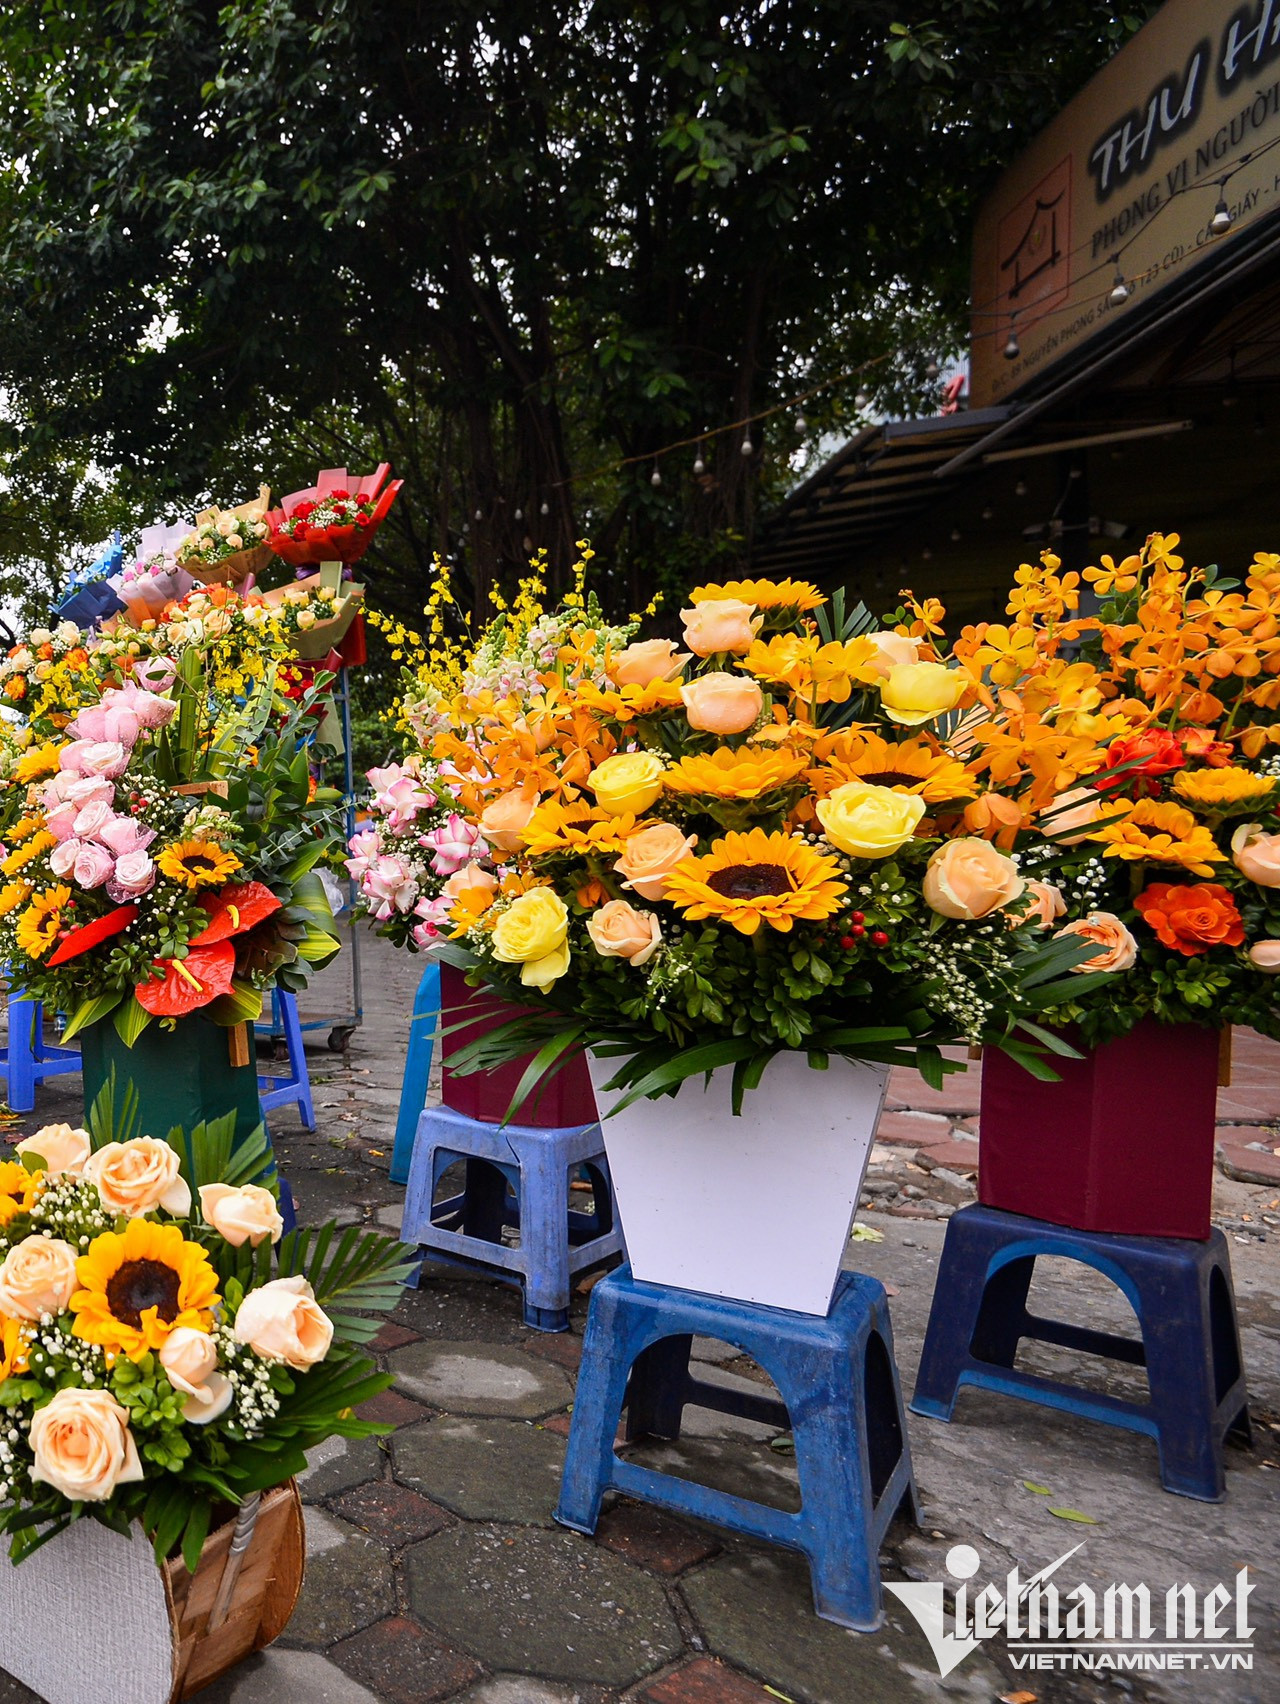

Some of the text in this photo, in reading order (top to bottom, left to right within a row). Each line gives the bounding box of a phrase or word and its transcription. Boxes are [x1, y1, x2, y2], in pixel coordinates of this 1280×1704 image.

[1092, 52, 1200, 190] THU
[1092, 182, 1160, 258] PHONG
[1195, 81, 1280, 177] NGƯỜI
